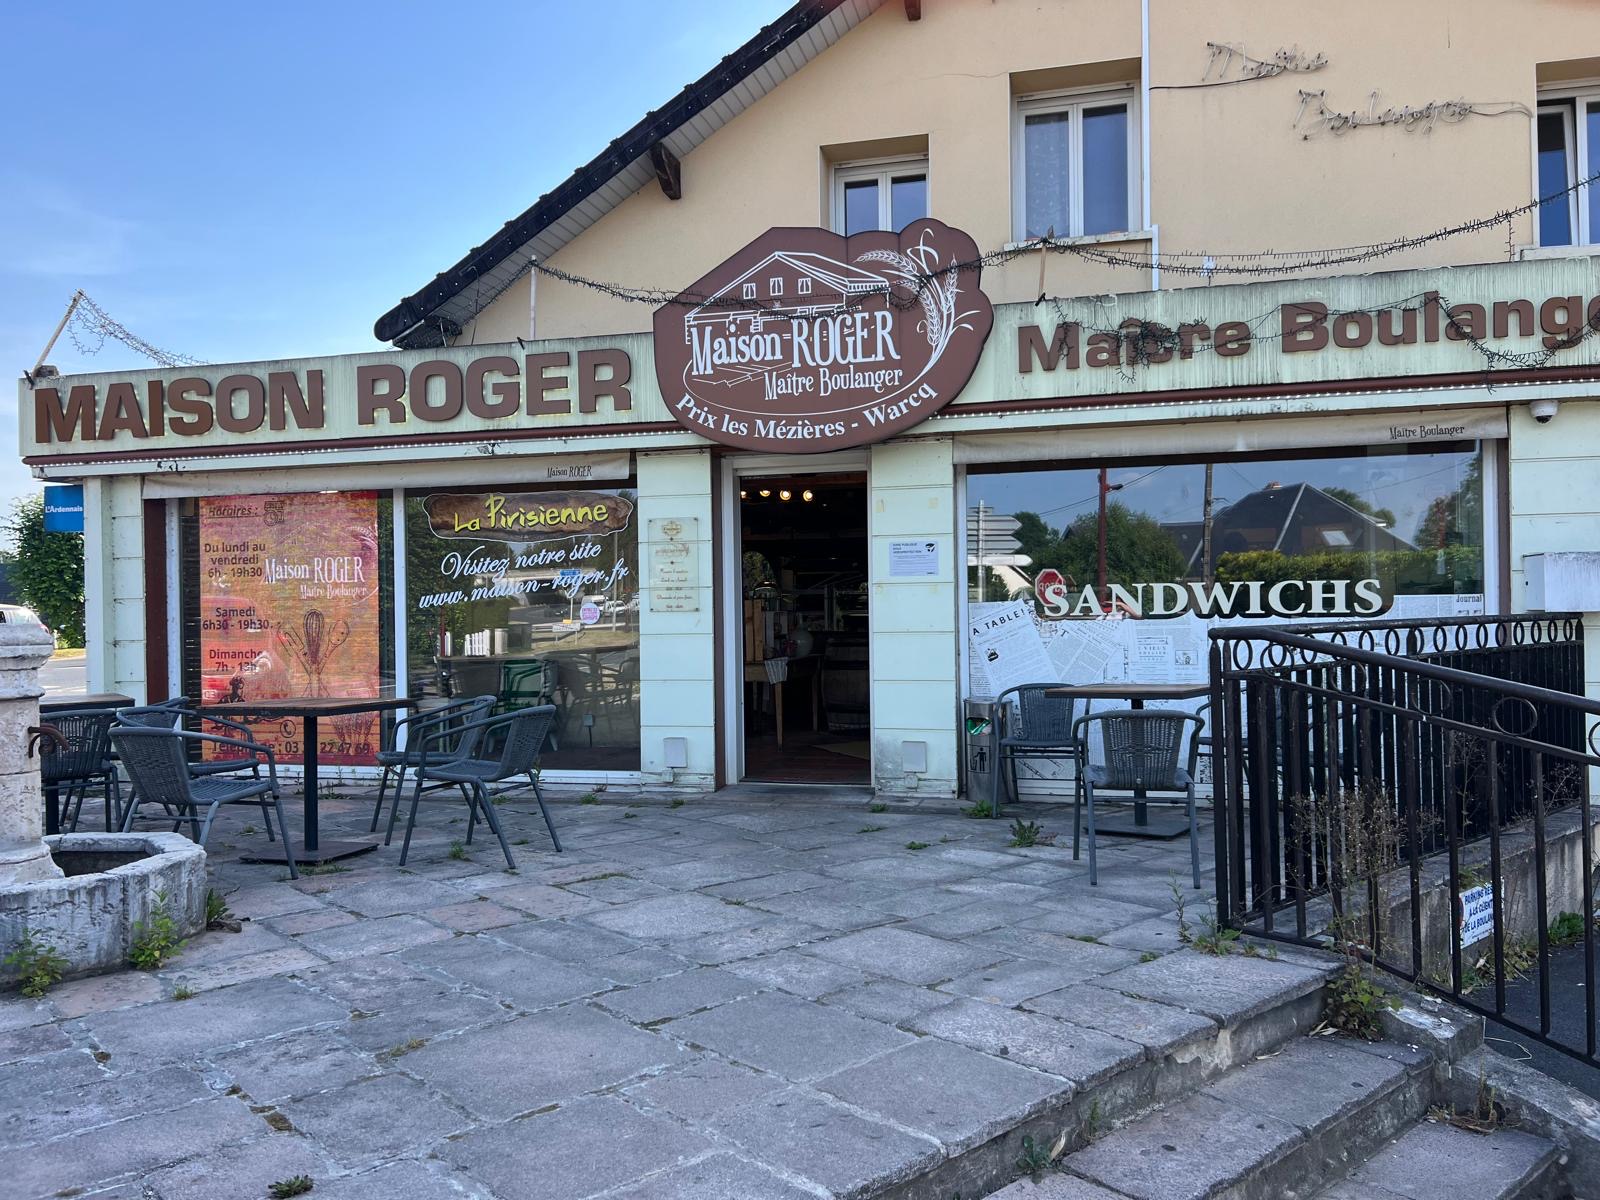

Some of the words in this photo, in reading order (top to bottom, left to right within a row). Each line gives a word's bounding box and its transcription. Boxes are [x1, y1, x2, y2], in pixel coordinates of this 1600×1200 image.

[690, 324, 783, 376] Maison
[791, 310, 901, 369] ROGER
[764, 370, 814, 401] Maître
[819, 365, 903, 397] Boulanger
[34, 369, 326, 444] MAISON
[356, 348, 632, 426] ROGER
[675, 392, 718, 429] Prix
[721, 413, 748, 436] les
[753, 418, 845, 440] Mézières
[862, 382, 938, 428] Warcq
[1419, 424, 1465, 439] Boulanger
[547, 467, 568, 478] Maison
[569, 465, 592, 478] ROGER
[45, 505, 83, 513] L'Ardennais
[454, 512, 481, 533] La
[485, 493, 609, 530] Pirisienne
[204, 543, 219, 553] Du
[221, 542, 249, 552] lundi
[252, 544, 266, 552] au
[211, 555, 259, 565] vendredi
[441, 545, 510, 579] Visitez
[515, 550, 566, 569] notre
[569, 541, 601, 559] site
[208, 567, 221, 578] 6h
[231, 567, 262, 577] 19h30
[265, 558, 310, 584] Maison
[314, 556, 365, 584] ROGER
[419, 558, 629, 609] www.maison-roger.fr
[326, 584, 368, 600] Boulanger
[1044, 578, 1384, 617] SANDWICHS
[1456, 594, 1482, 603] Journal
[215, 607, 255, 617] Samedi
[202, 619, 229, 630] 6h30
[238, 619, 269, 630] 19h30
[209, 648, 262, 659] Dimanche
[215, 661, 228, 672] 7h
[285, 741, 299, 753] 03
[320, 742, 334, 753] 22
[337, 742, 352, 753] 47
